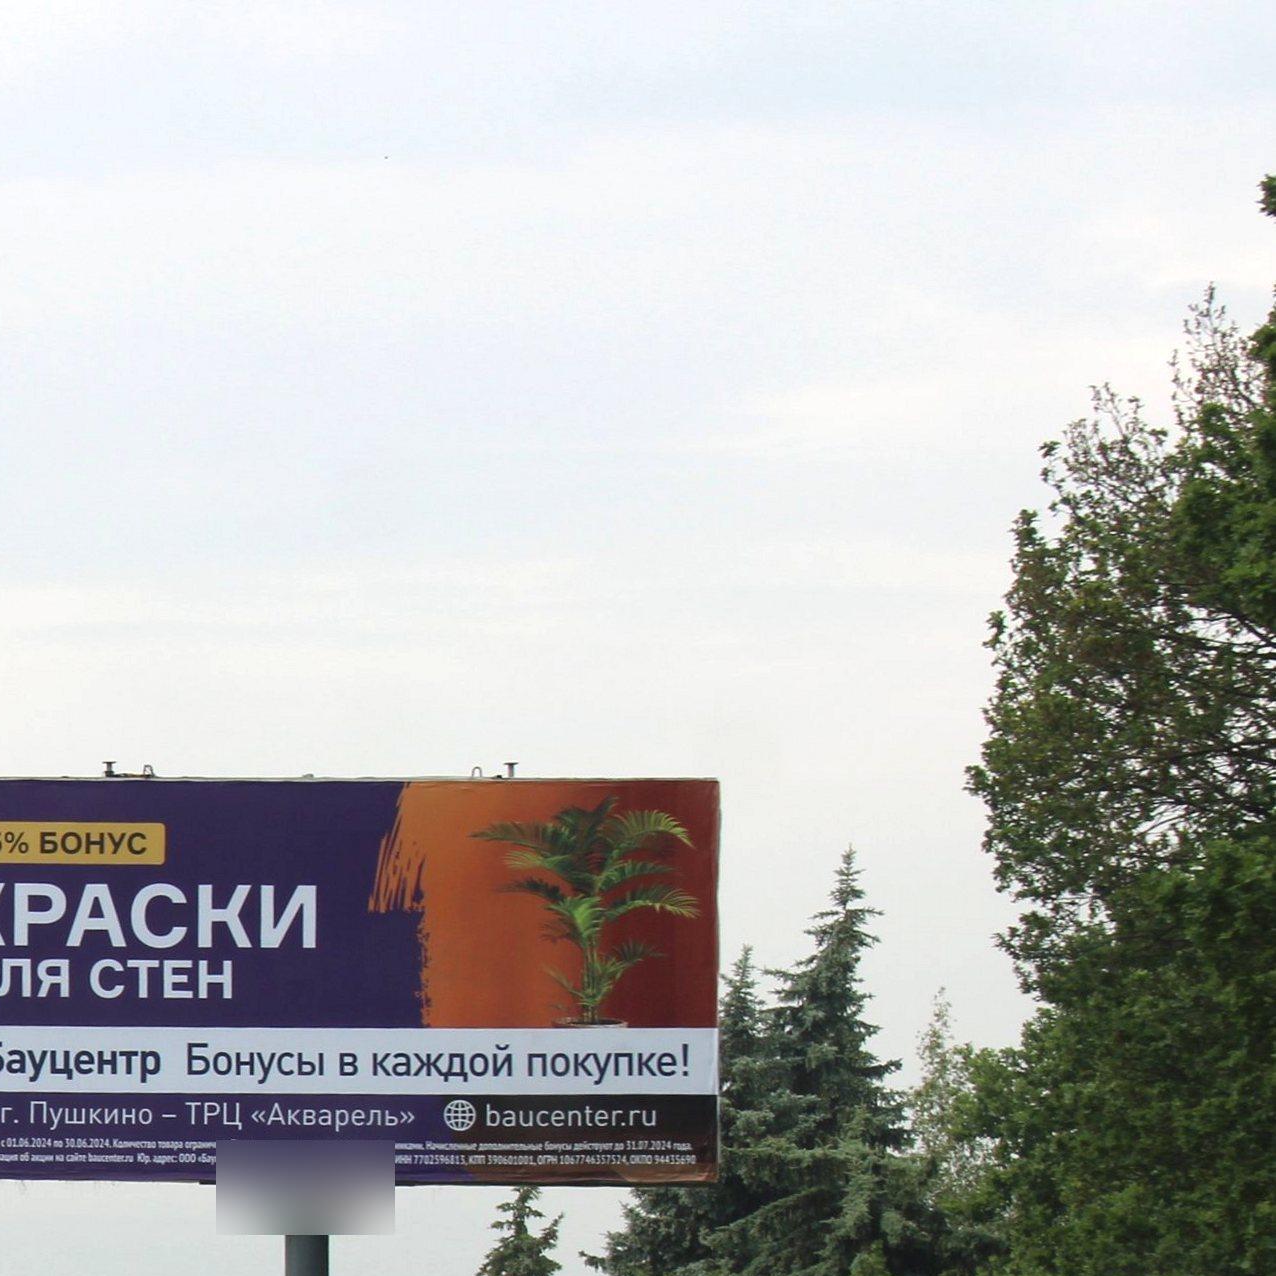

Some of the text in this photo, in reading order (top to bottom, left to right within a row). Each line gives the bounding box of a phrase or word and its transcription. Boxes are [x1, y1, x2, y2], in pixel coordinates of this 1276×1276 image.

[39, 830, 148, 856] БОНУС
[89, 957, 234, 1000] СТЕН
[185, 1041, 691, 1087] Бонусы в каждой покупке!
[0, 1106, 19, 1126] г.
[30, 1099, 154, 1132] Пушкино
[185, 1101, 242, 1131] ТРЦ
[250, 1101, 416, 1128] «Акварель»
[484, 1101, 658, 1128] baucenter.ru
[7, 1137, 52, 1148] 01.06.2024
[65, 1138, 112, 1148] 30.06.2024.
[544, 1140, 572, 1152] бонусы
[626, 1140, 672, 1150] 31.07.2024
